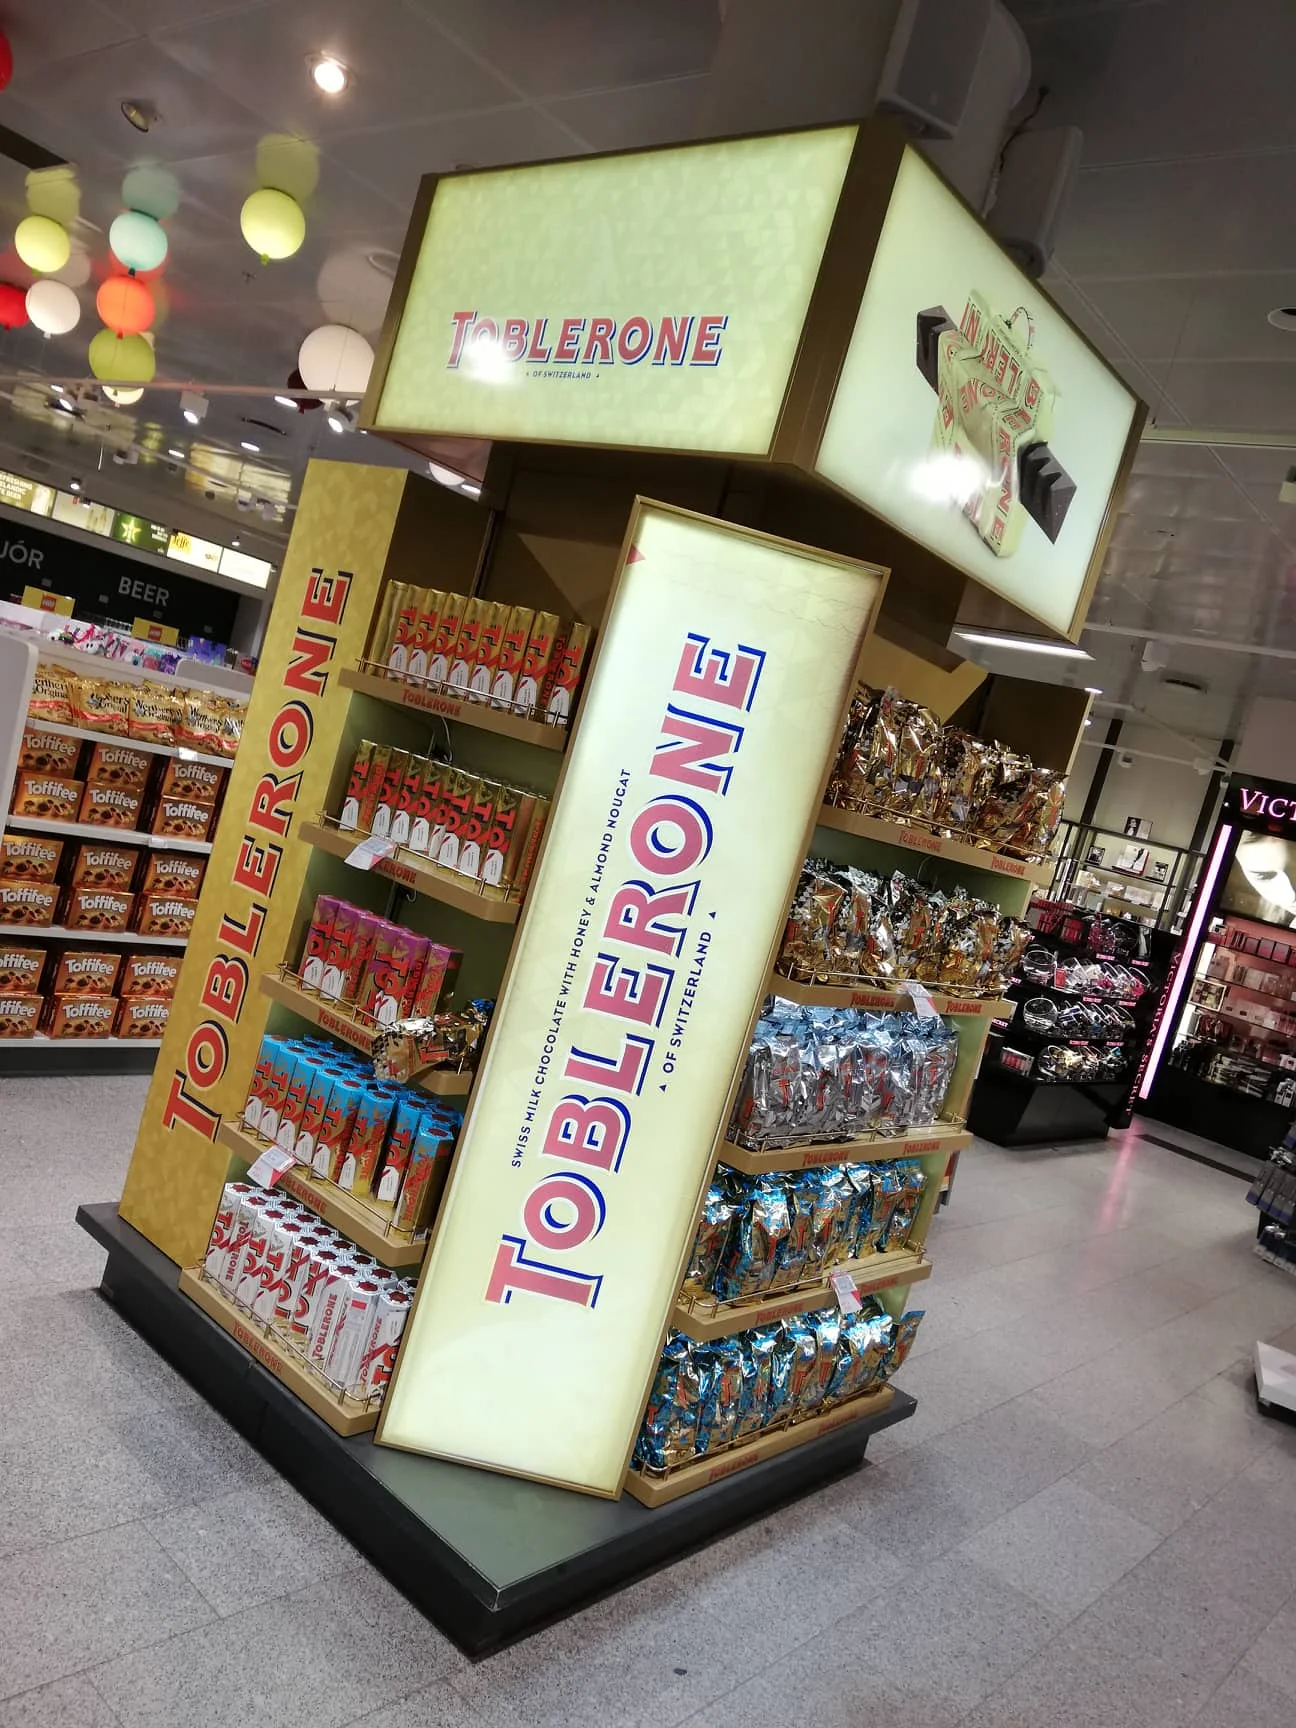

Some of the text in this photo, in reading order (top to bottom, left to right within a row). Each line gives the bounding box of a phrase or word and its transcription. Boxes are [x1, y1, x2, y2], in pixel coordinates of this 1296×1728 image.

[447, 311, 728, 368] TOBLERONE
[542, 371, 591, 379] SWITZERLAND
[118, 576, 170, 607] BEER
[24, 734, 76, 756] Toffifee
[100, 749, 148, 770] Toffifee
[173, 764, 218, 784] Toffifee
[25, 780, 78, 802] Toffifee
[90, 789, 138, 810] Toffifee
[163, 802, 209, 822] Toffifee
[3, 842, 57, 861] Toffifee
[84, 851, 132, 870] Toffifee
[163, 568, 353, 1143] TOBLERONE
[154, 860, 200, 878] Toffifee
[0, 888, 53, 906] Toffifee
[78, 896, 128, 913] Toffifee
[150, 902, 195, 919] Toffifee
[66, 958, 114, 975] Toffifee
[132, 962, 177, 977] Toffifee
[484, 632, 766, 1309] TOBLERONE
[512, 769, 631, 1167] SWISS MILK CHOCOLATE WITH HONEY & ALMOND NOUGAT
[62, 1004, 112, 1019] Toffifee
[663, 932, 712, 1073] OF SWITZERLAND
[312, 1293, 338, 1358] TOBLERONE
